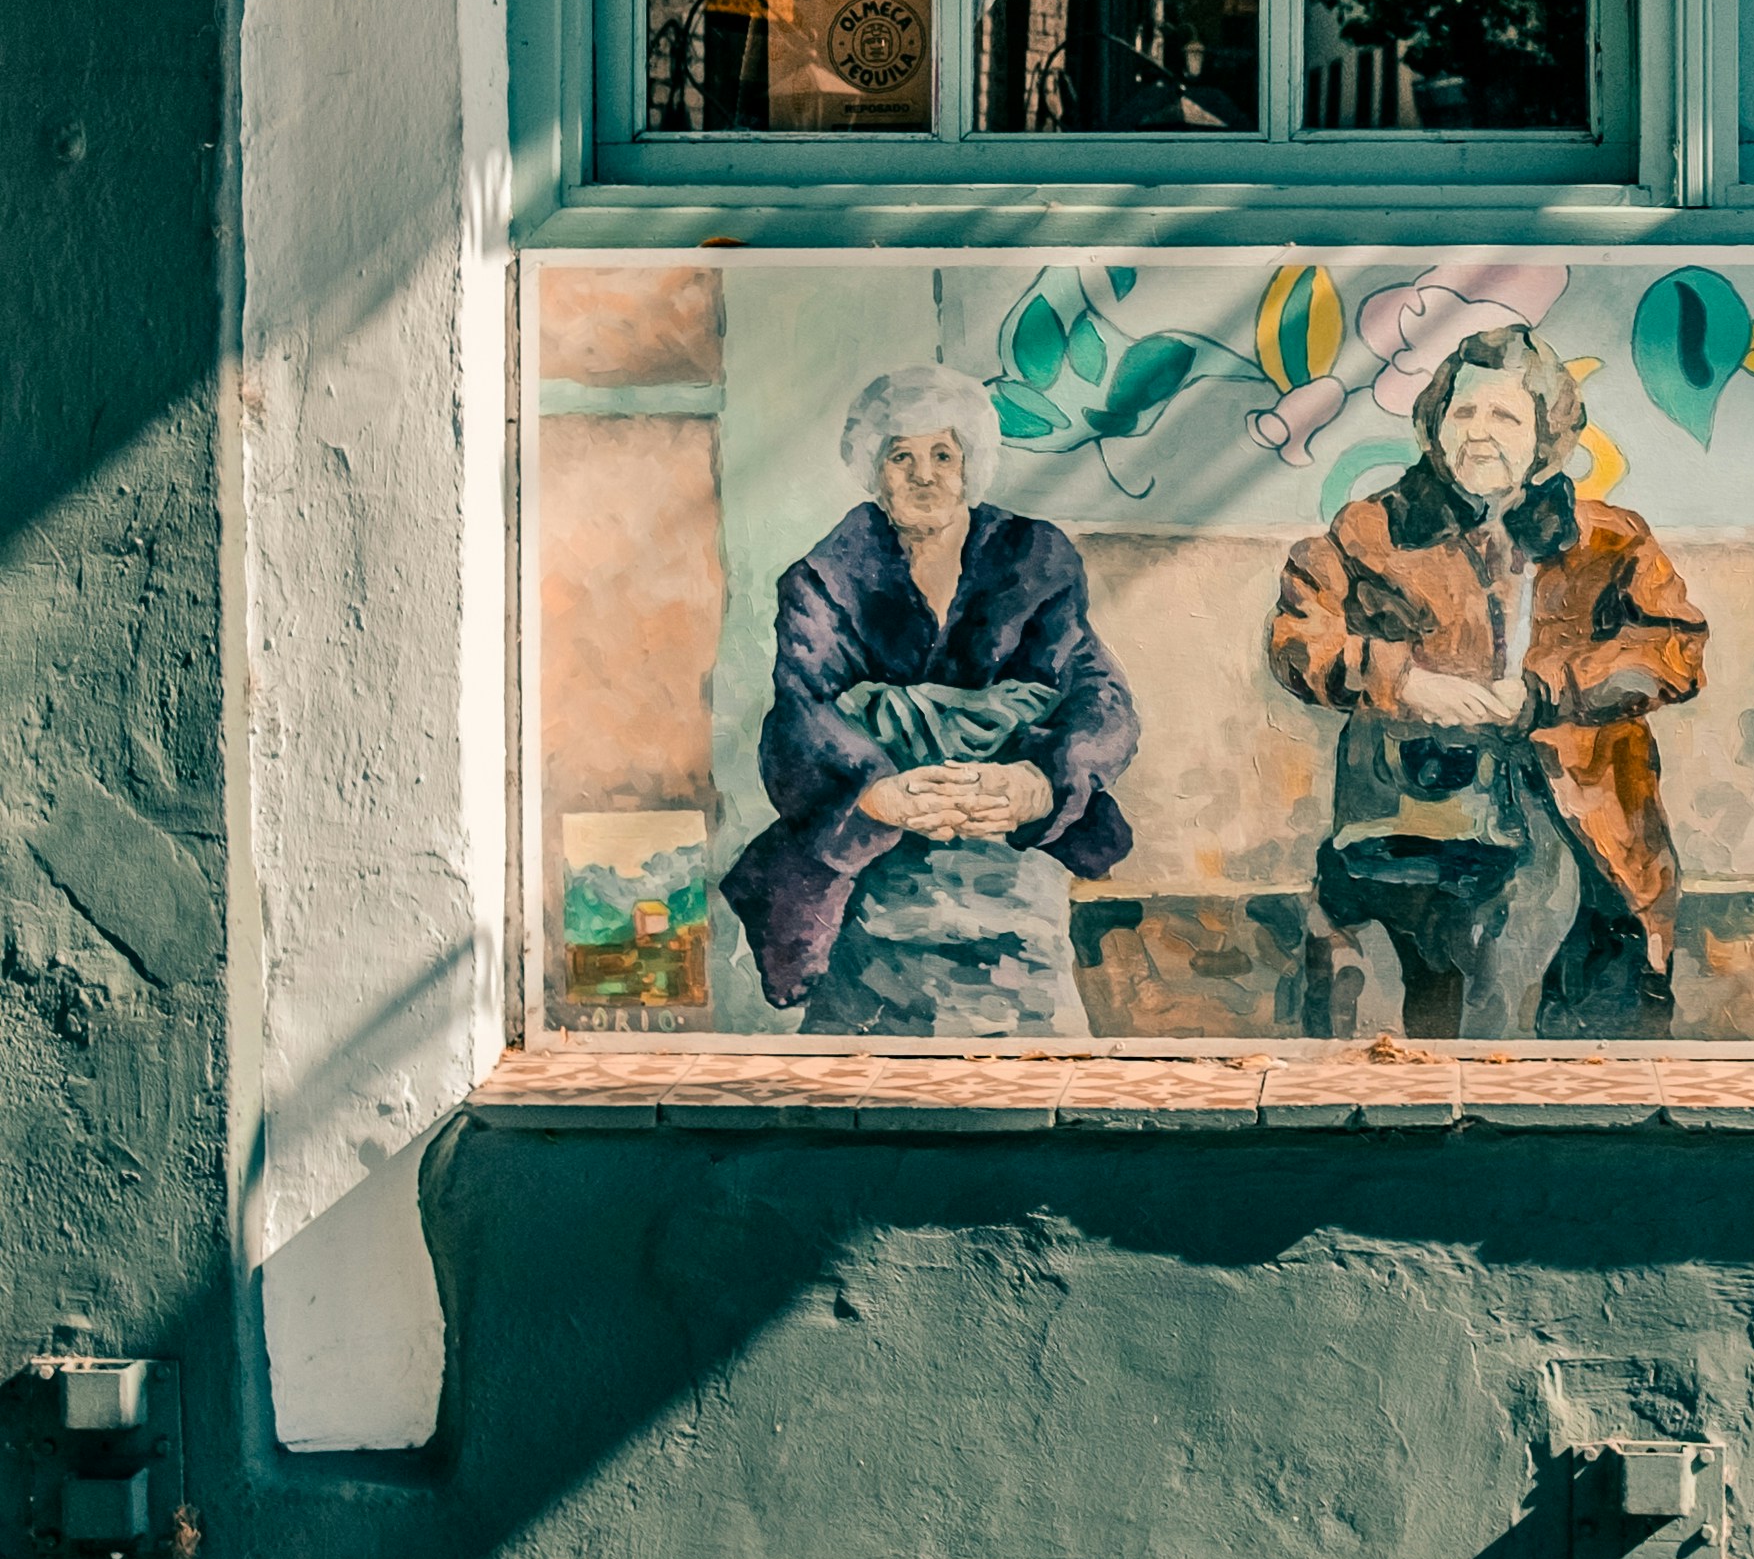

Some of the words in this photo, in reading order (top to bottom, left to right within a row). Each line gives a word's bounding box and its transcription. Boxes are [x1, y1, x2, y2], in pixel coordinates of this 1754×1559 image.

[838, 0, 914, 33] OLMECA
[839, 52, 918, 87] TEQUILA
[844, 103, 911, 113] REPOSADO
